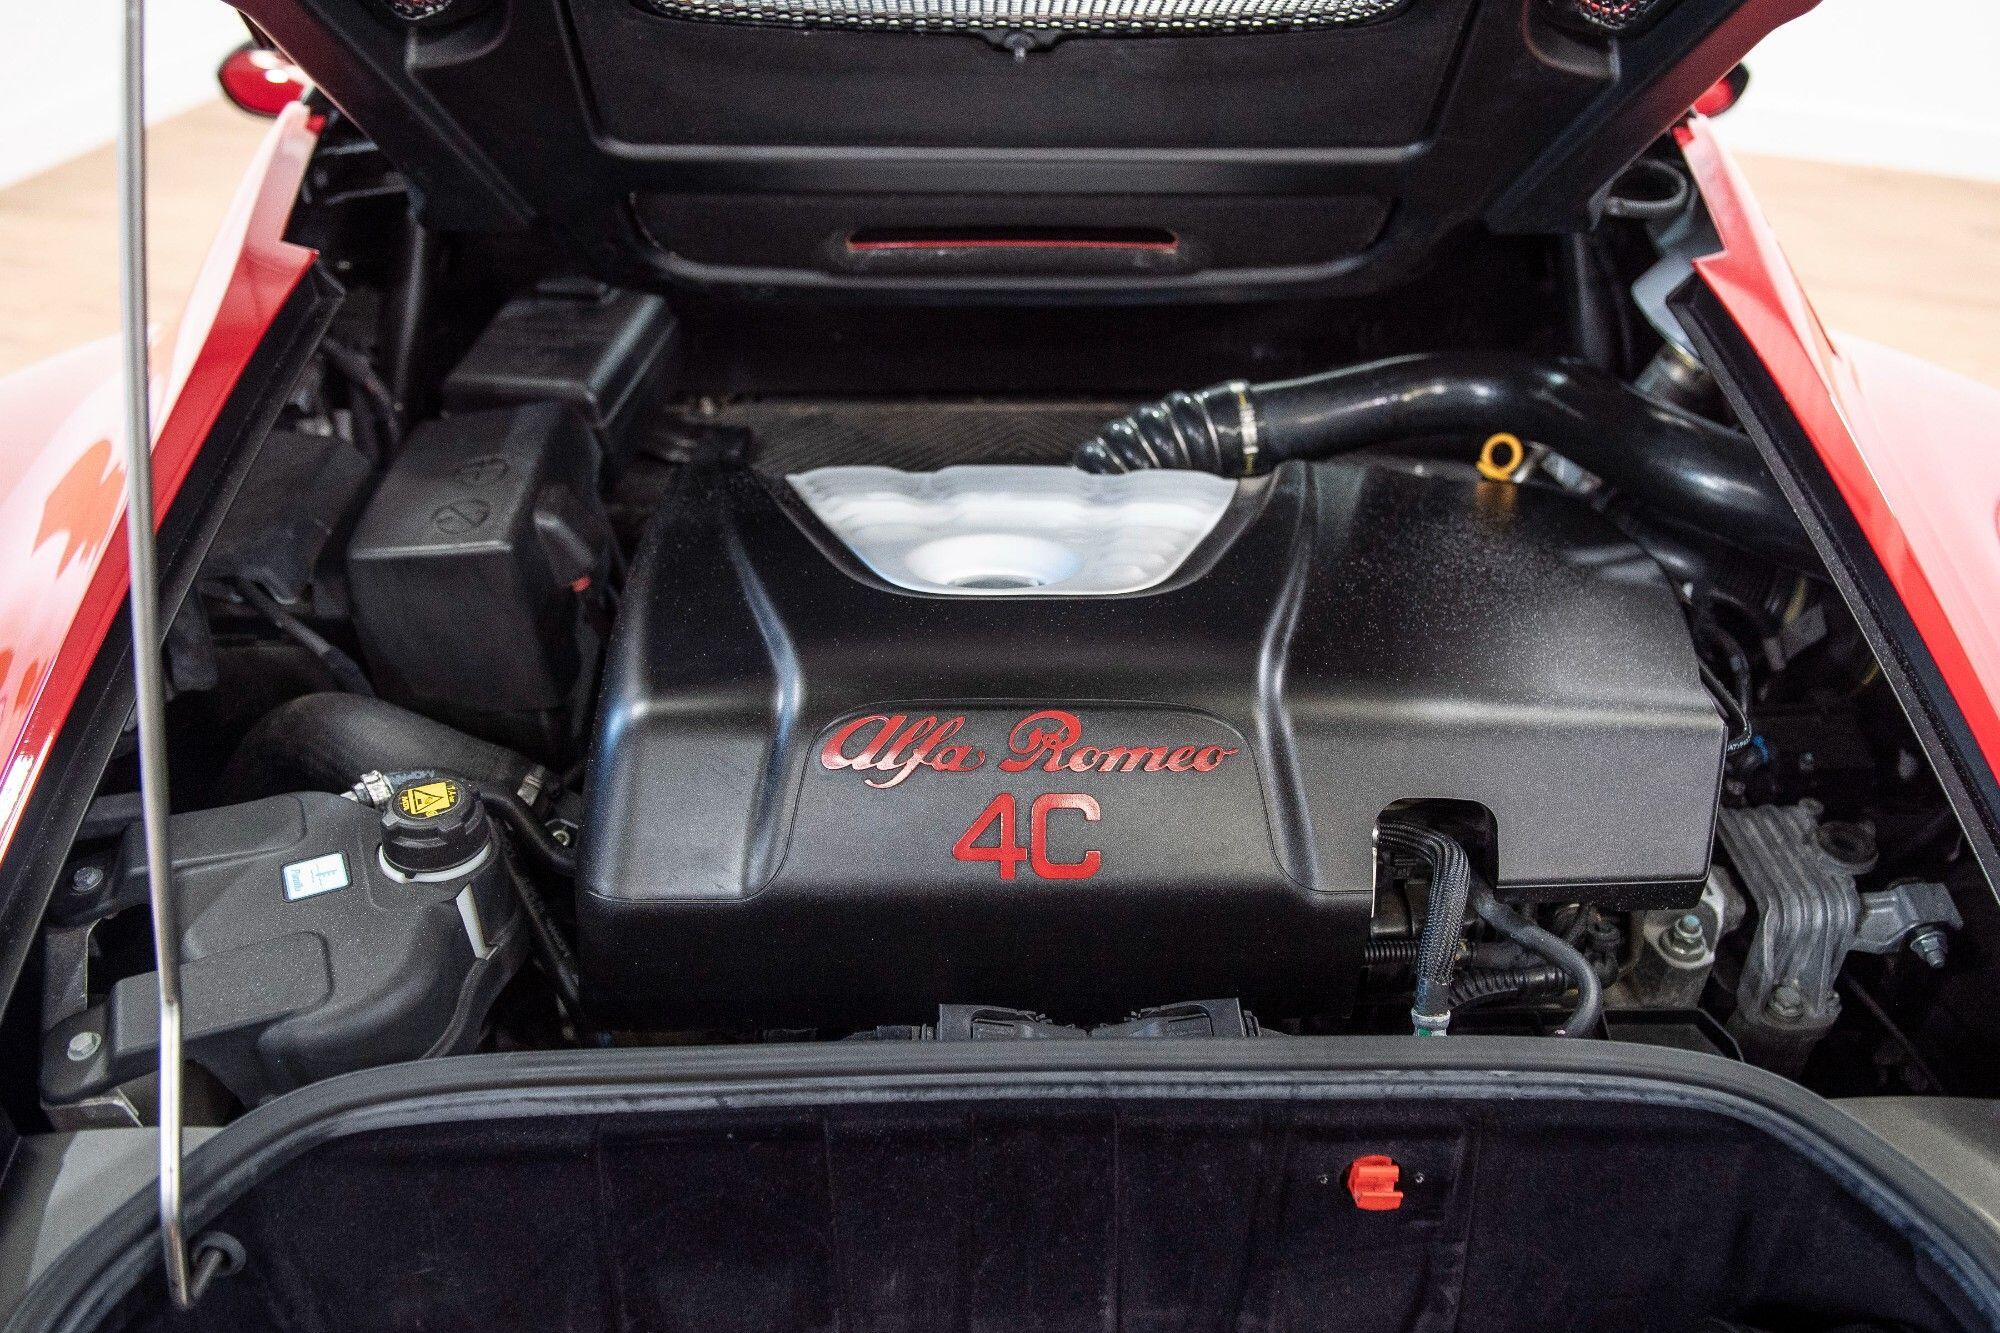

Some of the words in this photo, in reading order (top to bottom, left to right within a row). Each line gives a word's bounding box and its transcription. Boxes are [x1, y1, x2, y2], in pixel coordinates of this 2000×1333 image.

[820, 713, 987, 788] Alfa
[998, 709, 1239, 774] Romeo
[952, 792, 1102, 881] 4C
